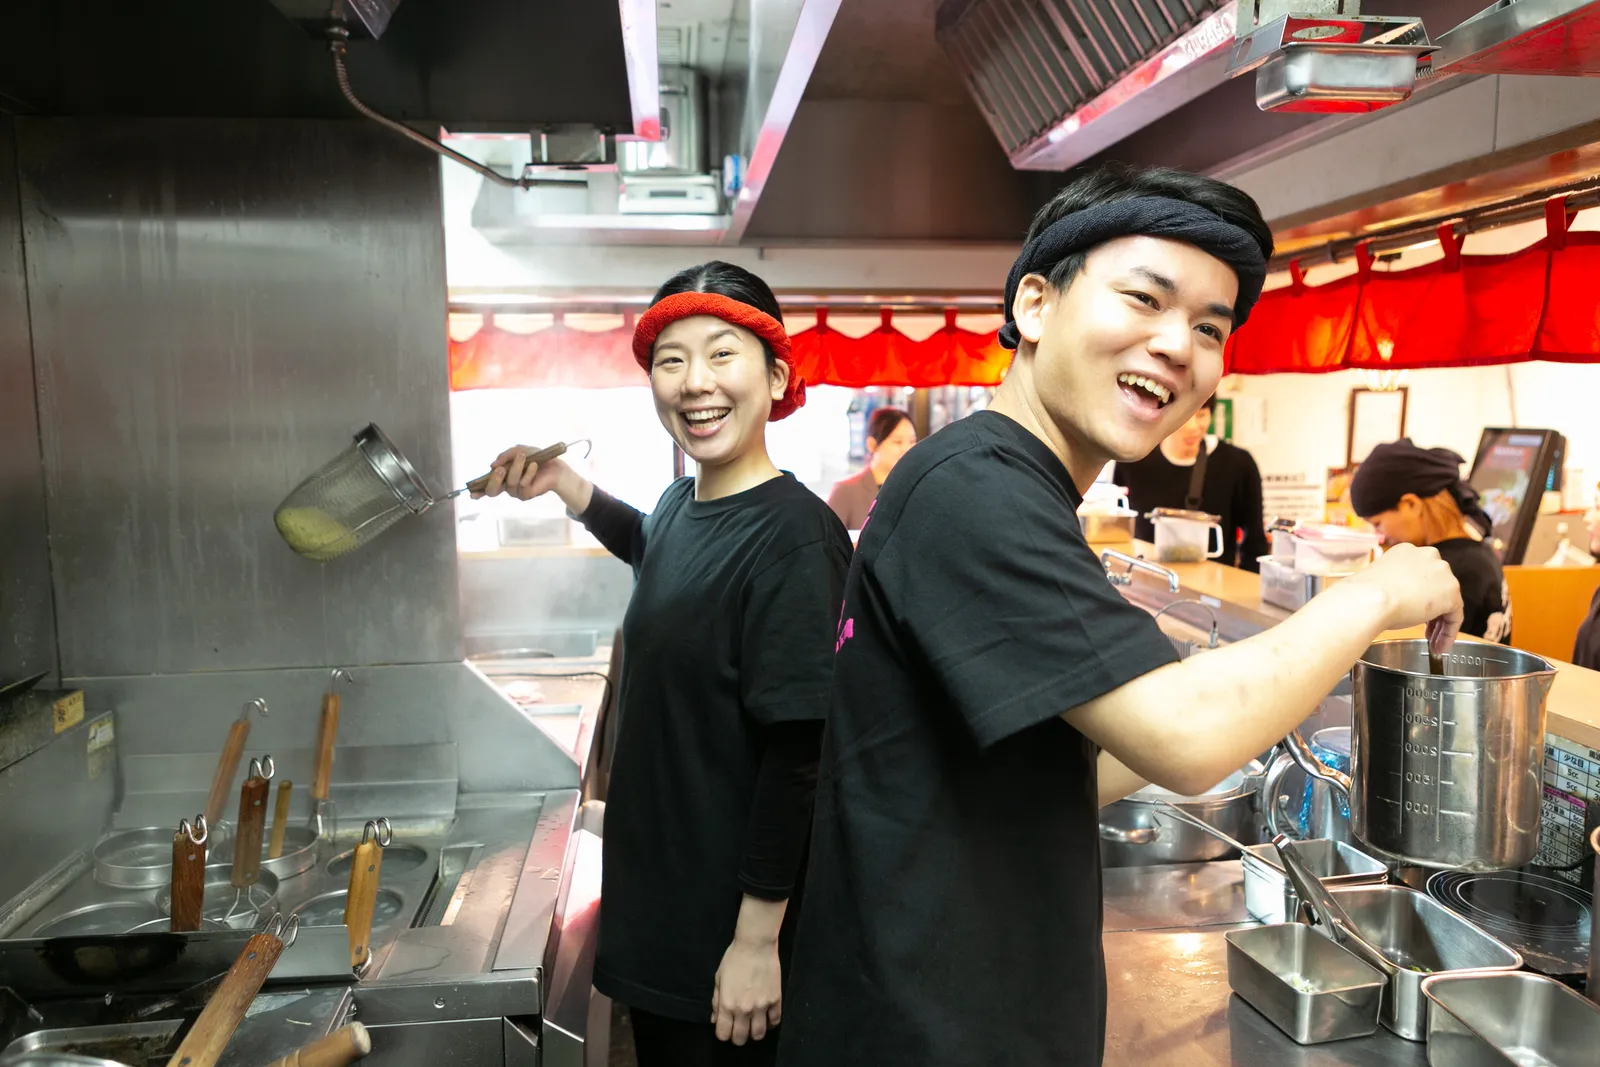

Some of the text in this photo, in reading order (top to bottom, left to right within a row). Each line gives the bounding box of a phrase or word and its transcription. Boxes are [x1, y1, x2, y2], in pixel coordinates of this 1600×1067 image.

[1451, 654, 1482, 666] 3000
[1567, 769, 1579, 779] 5cc
[1566, 781, 1578, 792] 5cc
